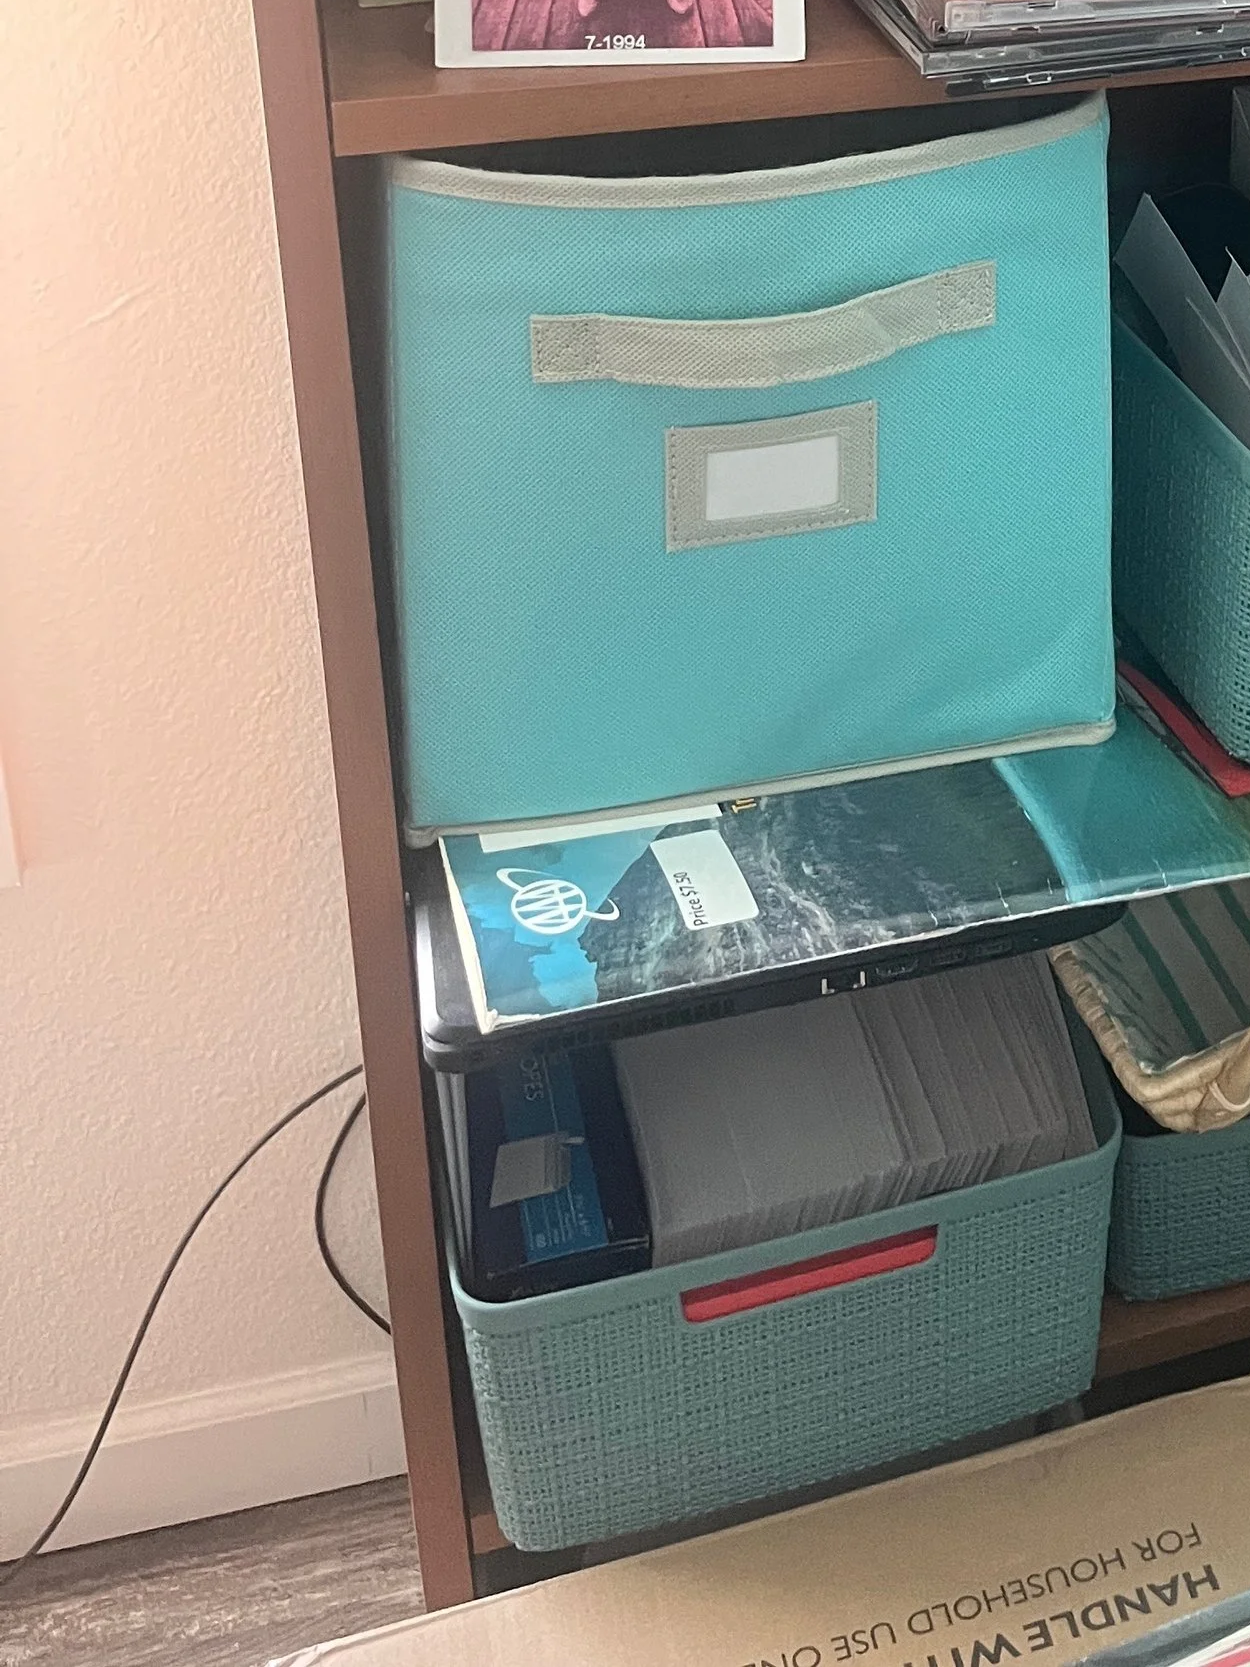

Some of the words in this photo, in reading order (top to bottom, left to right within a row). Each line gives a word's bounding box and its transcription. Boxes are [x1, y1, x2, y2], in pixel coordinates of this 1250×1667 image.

[584, 34, 646, 50] 7-1994
[688, 898, 709, 927] Price
[1135, 1522, 1203, 1563] FOR
[907, 1547, 1125, 1635] HOUSEHOLD
[1022, 1564, 1221, 1652] HANDLE
[742, 1645, 821, 1667] ON
[830, 1621, 898, 1662] USE
